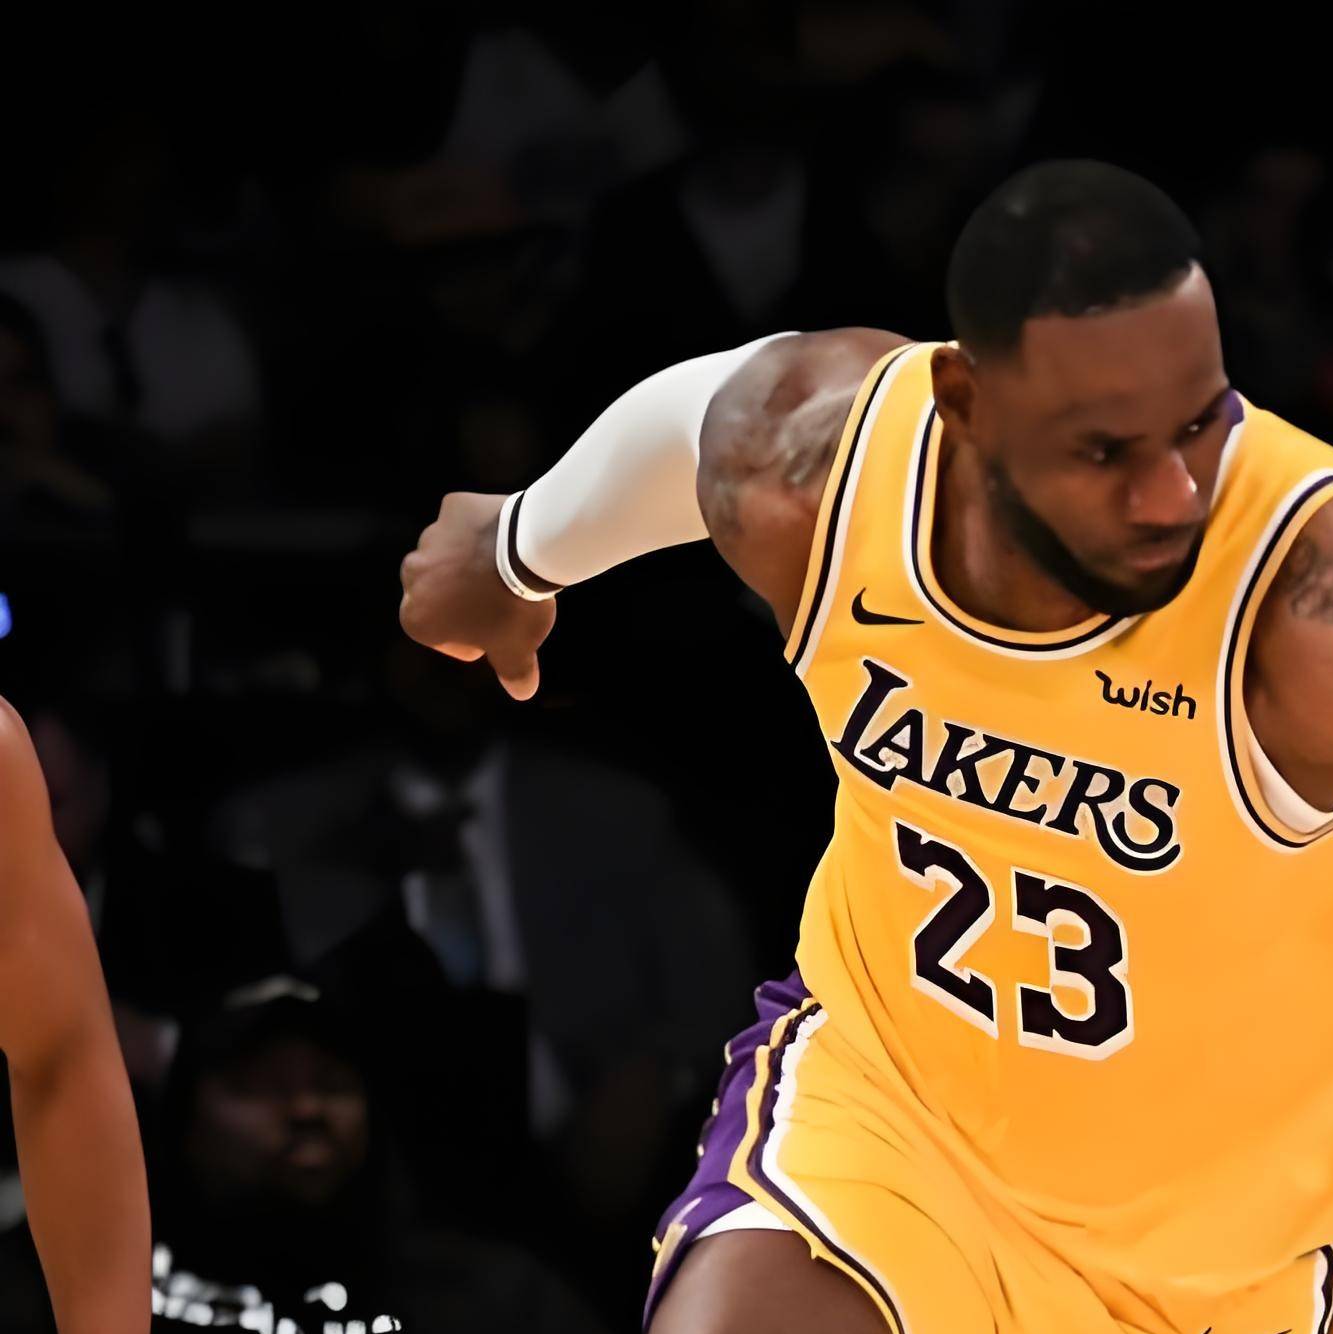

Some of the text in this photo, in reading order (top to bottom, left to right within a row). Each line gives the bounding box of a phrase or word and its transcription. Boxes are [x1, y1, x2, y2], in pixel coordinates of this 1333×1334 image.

[829, 656, 1182, 872] LAKERS
[1094, 669, 1197, 720] wish
[892, 819, 1134, 1060] 23
